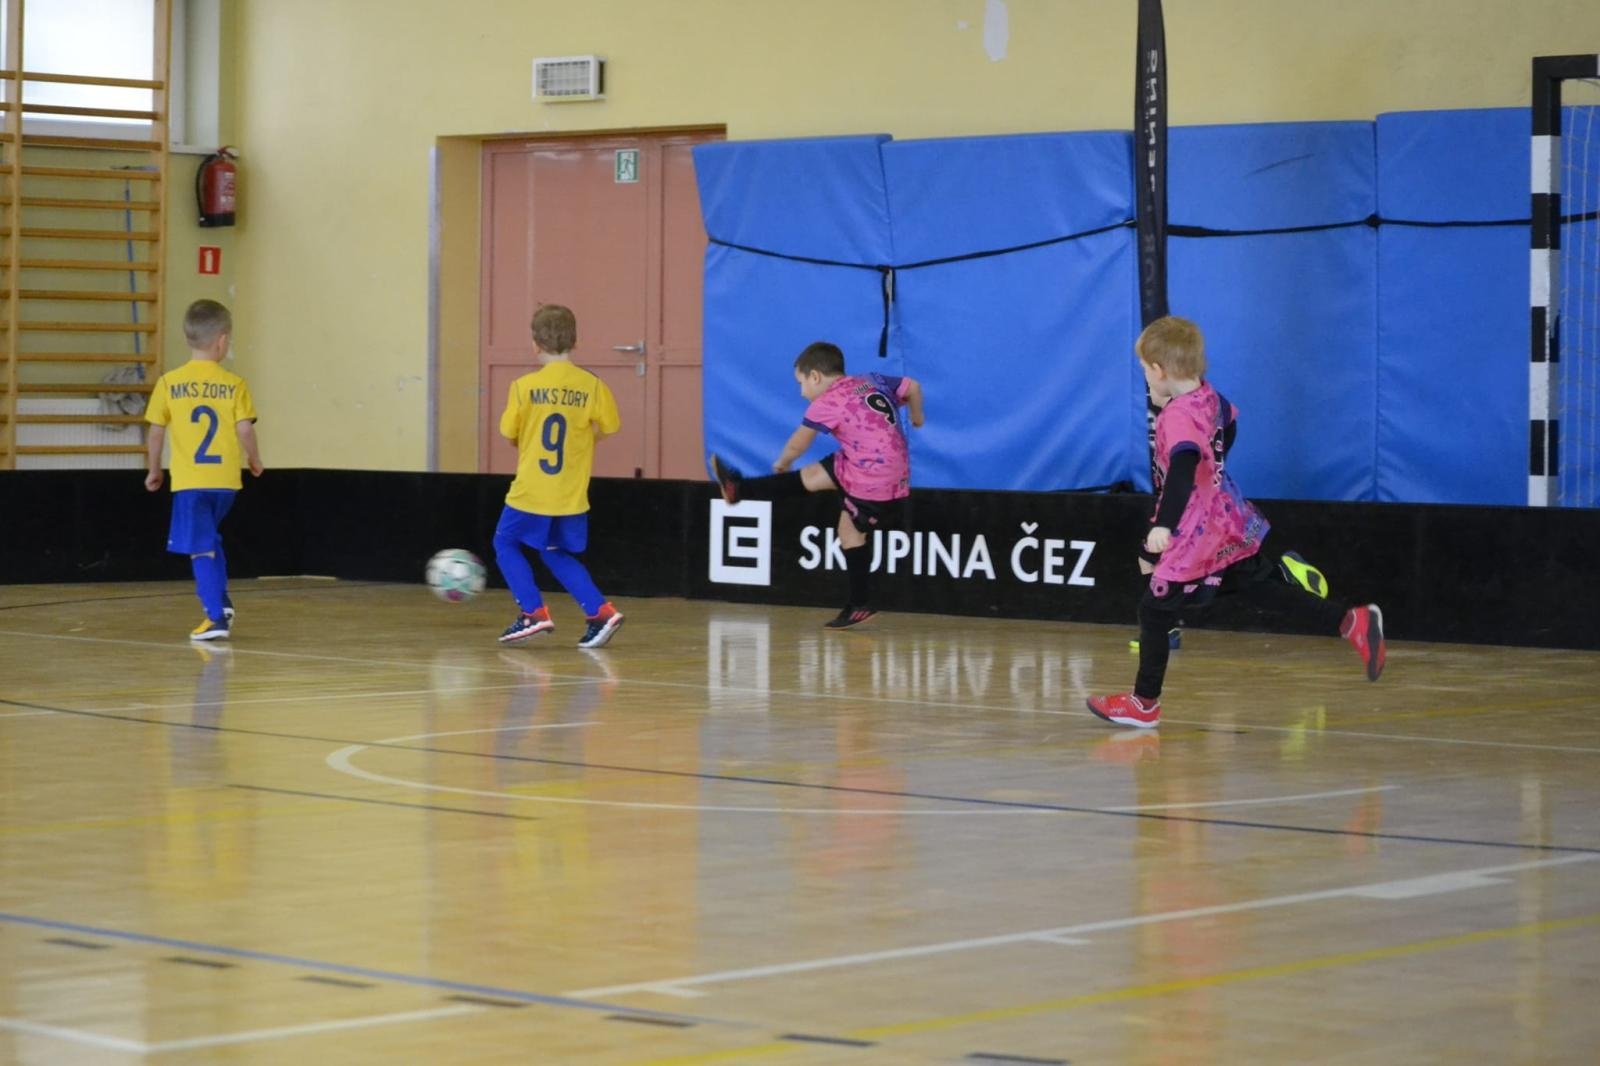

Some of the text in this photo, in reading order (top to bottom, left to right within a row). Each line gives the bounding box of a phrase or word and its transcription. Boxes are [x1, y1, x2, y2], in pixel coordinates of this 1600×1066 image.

[171, 382, 199, 399] MKS
[530, 388, 559, 405] MKS
[865, 392, 897, 426] 9
[191, 405, 222, 464] 2
[539, 413, 567, 475] 9
[1010, 522, 1097, 587] ČEZ
